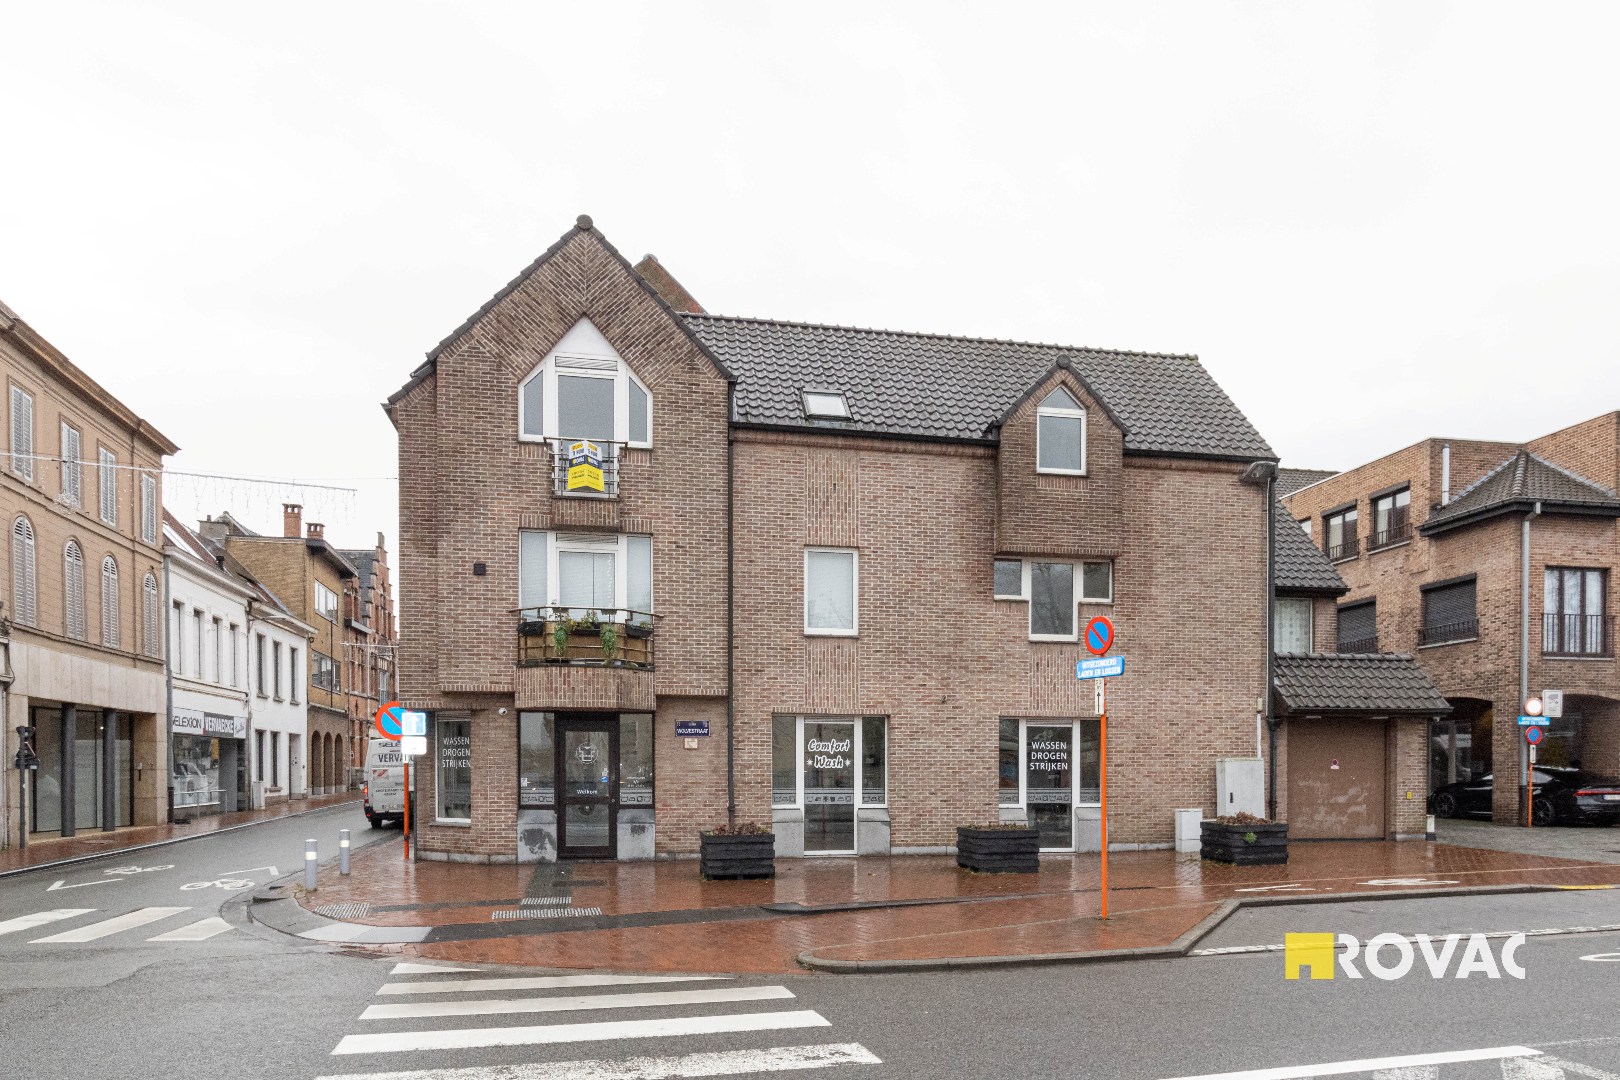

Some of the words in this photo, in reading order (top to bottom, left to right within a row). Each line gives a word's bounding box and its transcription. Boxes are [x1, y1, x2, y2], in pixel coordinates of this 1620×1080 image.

[1078, 669, 1094, 678] LADEN
[1102, 666, 1121, 676] LOSSEN
[443, 736, 470, 746] WASSEN
[1031, 741, 1067, 750] WASSEN
[808, 739, 850, 754] Comfort
[442, 748, 471, 757] DROGEN
[1031, 751, 1067, 760] DROGEN
[442, 759, 471, 769] STRIJKEN
[814, 755, 844, 768] Wash
[1029, 761, 1068, 771] STRIJKEN
